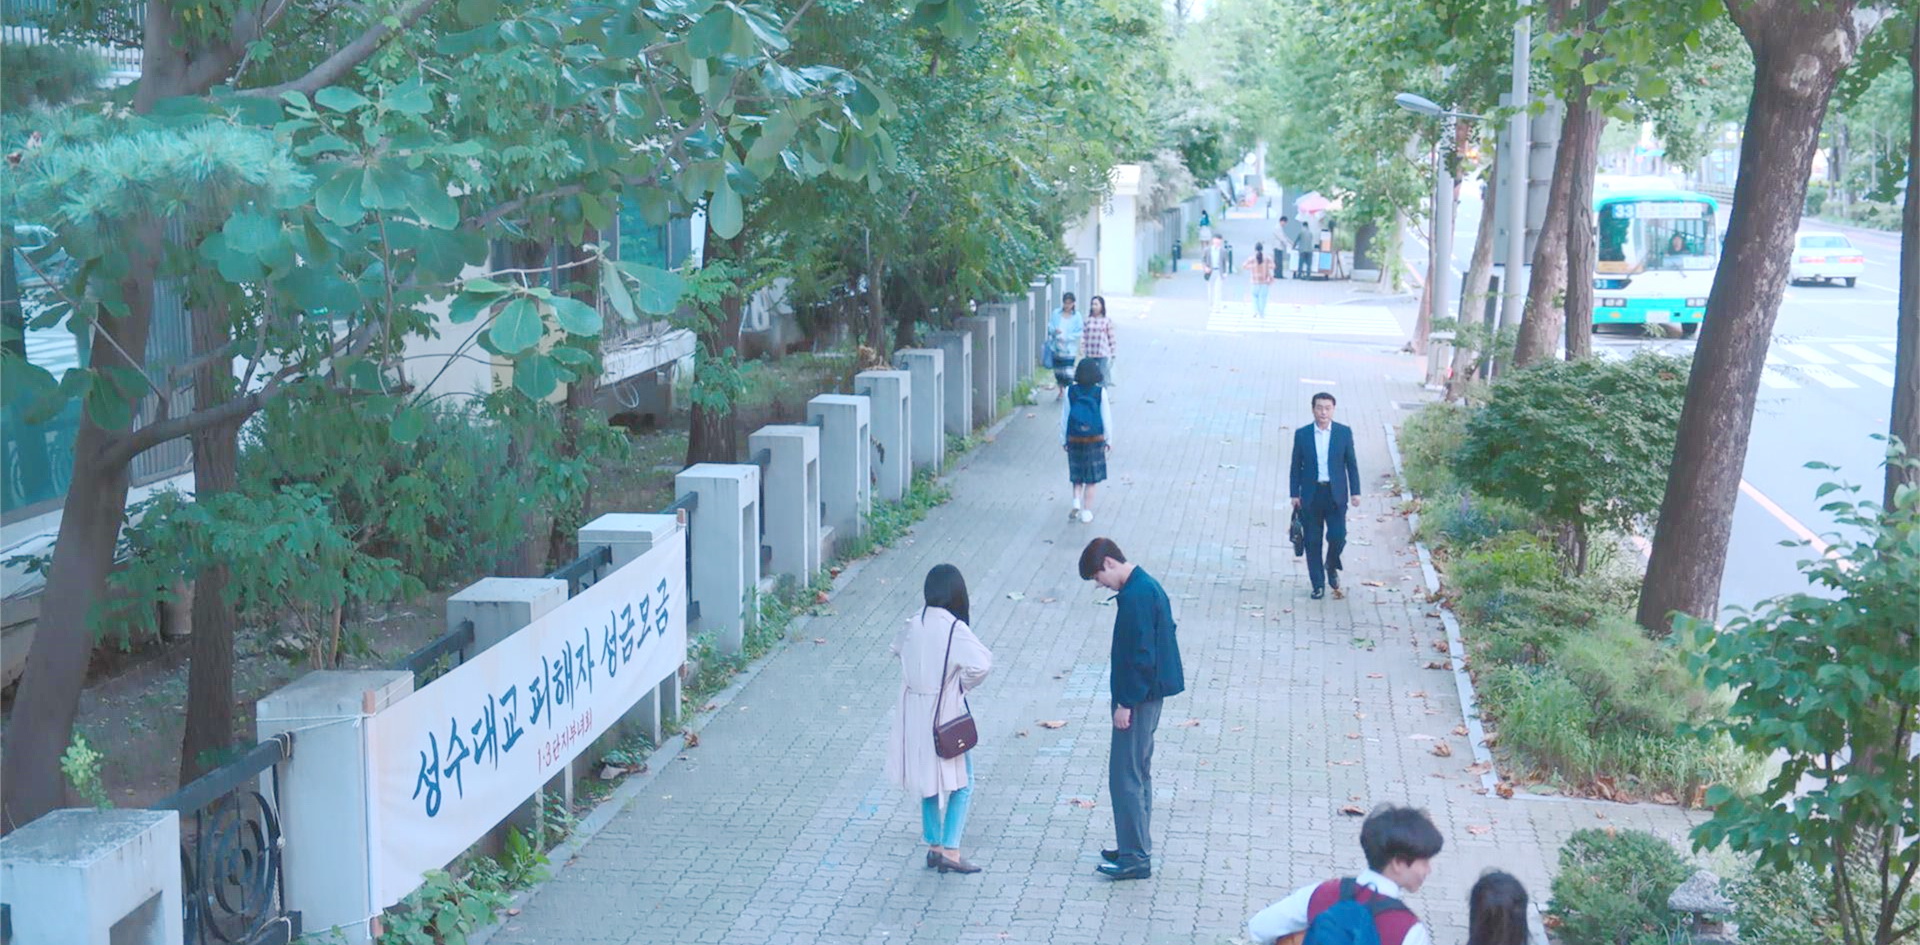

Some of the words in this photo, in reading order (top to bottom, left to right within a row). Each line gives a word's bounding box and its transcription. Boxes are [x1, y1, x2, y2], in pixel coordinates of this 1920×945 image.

[1614, 203, 1635, 218] 33
[412, 684, 524, 818] 성수대교
[528, 627, 595, 730] 피해자
[600, 577, 670, 678] 성금모금
